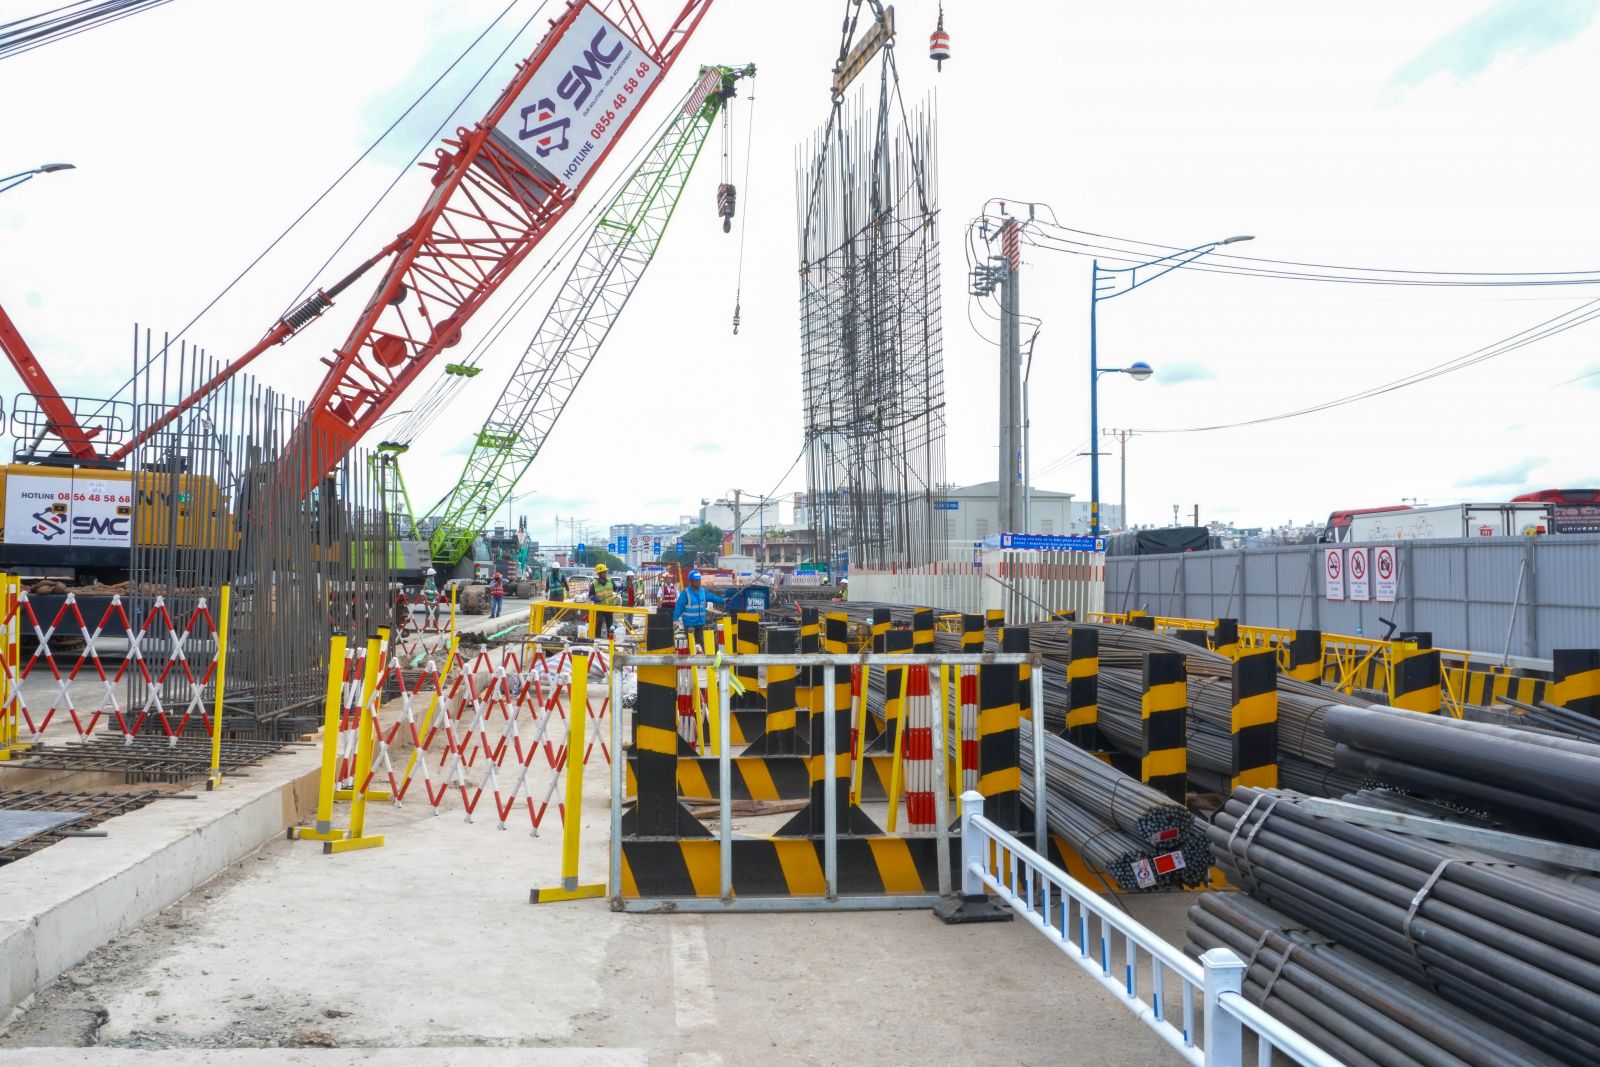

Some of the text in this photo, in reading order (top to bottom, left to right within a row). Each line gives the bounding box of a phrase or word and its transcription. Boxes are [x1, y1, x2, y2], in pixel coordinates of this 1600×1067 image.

[557, 25, 624, 111] SMC
[562, 61, 650, 180] HOTLINE 0856 48 58 68
[21, 491, 55, 500] HOTLINE
[57, 492, 70, 501] 08
[73, 493, 86, 501] 56
[88, 494, 101, 502] 48
[118, 495, 130, 503] 68
[72, 516, 130, 536] SMC
